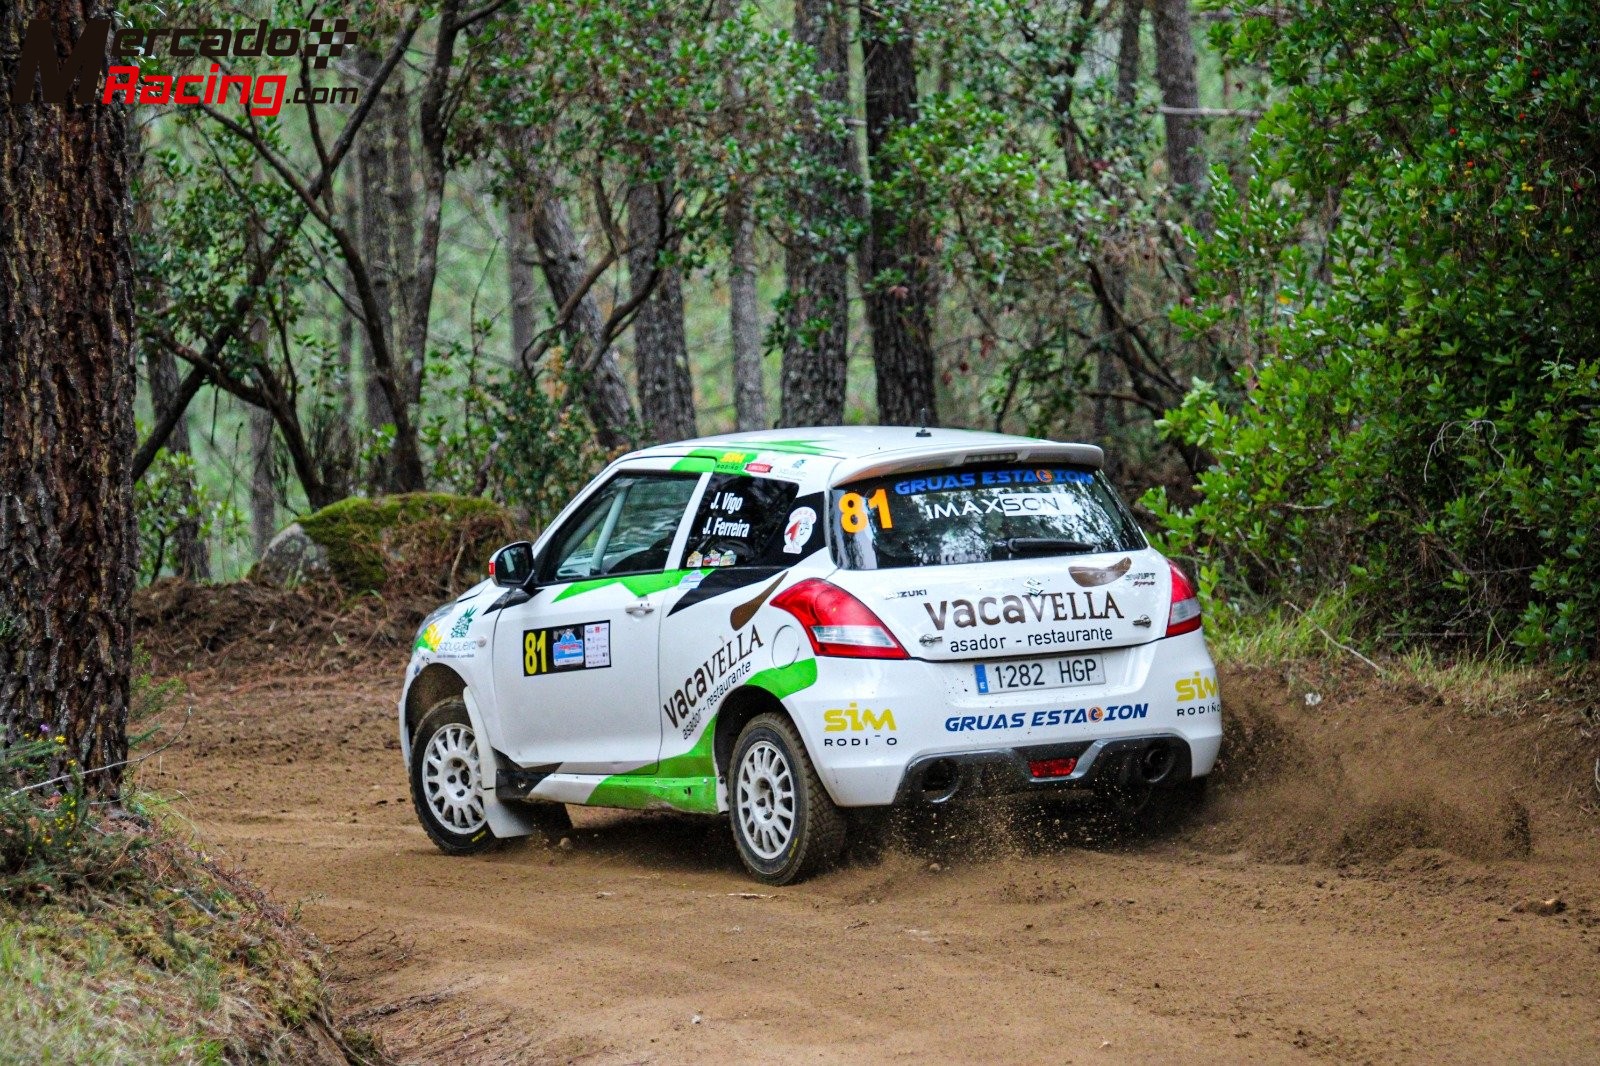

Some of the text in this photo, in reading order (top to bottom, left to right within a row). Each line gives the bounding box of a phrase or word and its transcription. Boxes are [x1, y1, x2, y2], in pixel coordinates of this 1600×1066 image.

[895, 473, 975, 495] GRUAS
[710, 492, 743, 515] J. Vigo
[838, 488, 893, 533] 81
[702, 517, 750, 537] J. Ferreira
[524, 630, 548, 675] 81
[950, 635, 1007, 653] asador
[1027, 627, 1114, 647] restaurante
[706, 661, 752, 709] restaurante
[994, 662, 1046, 689] 1282
[1058, 658, 1097, 684] HGP
[945, 703, 1149, 732] GRUAS ESTACION
